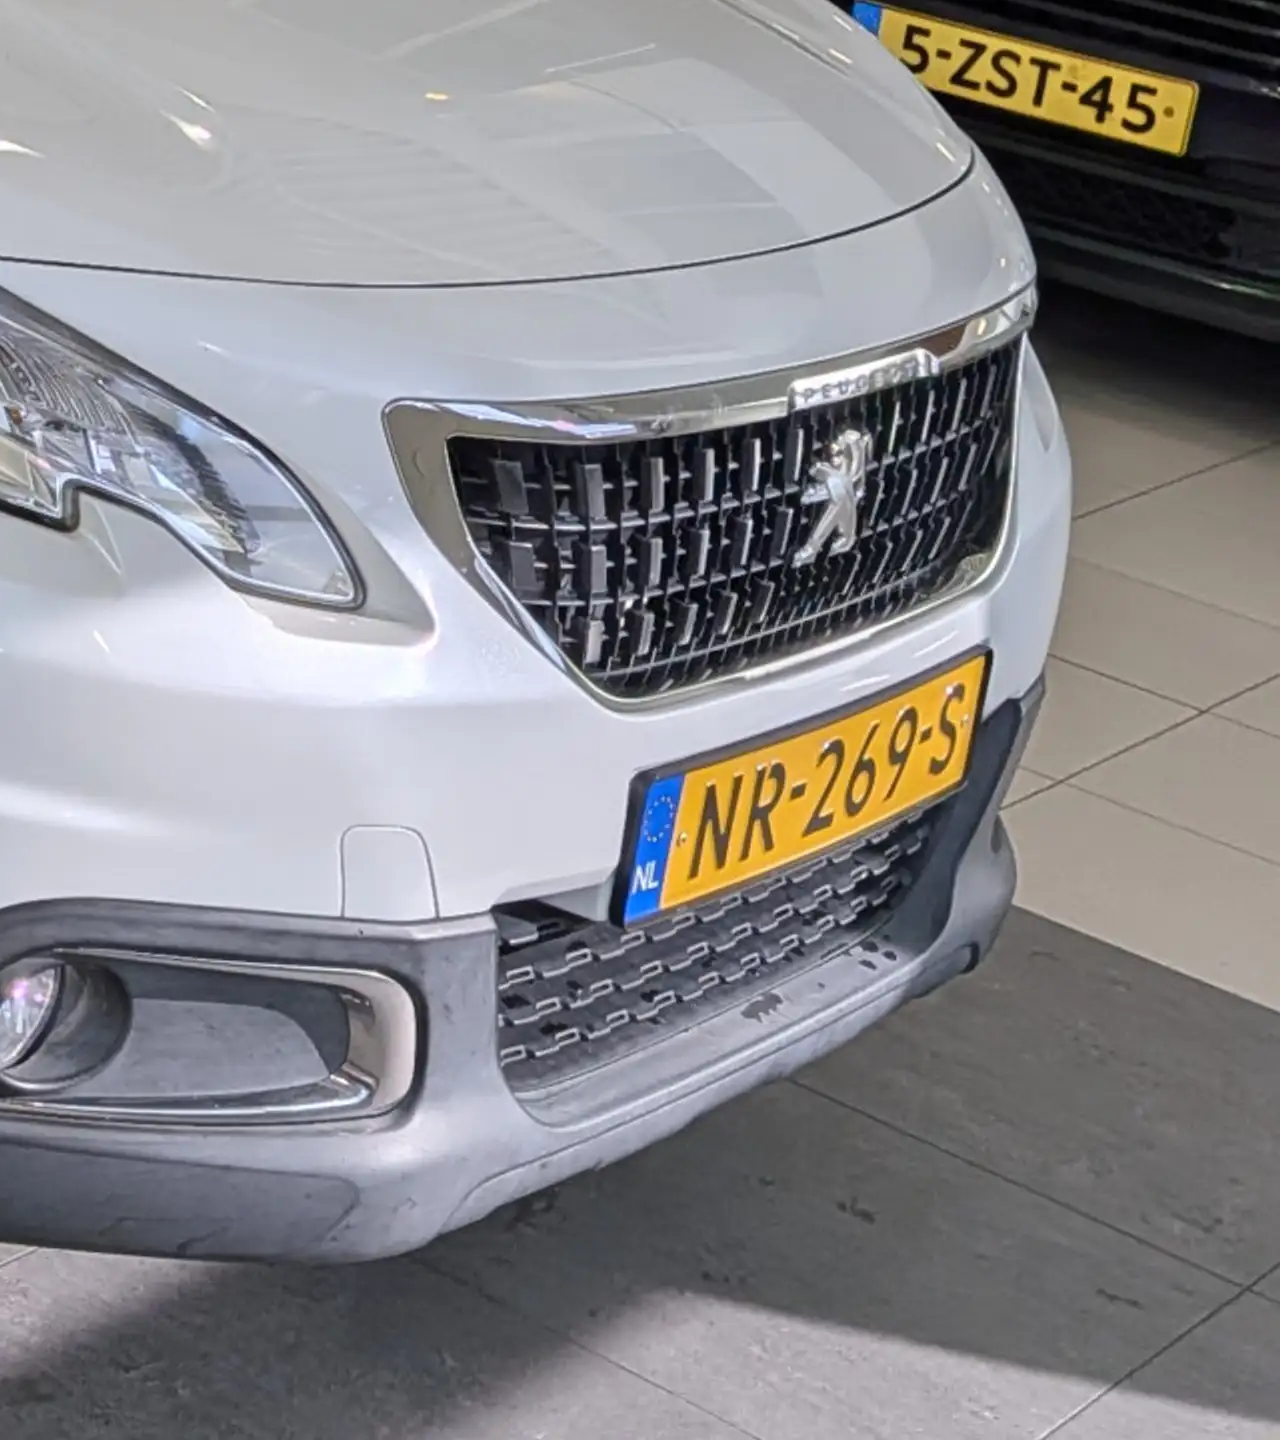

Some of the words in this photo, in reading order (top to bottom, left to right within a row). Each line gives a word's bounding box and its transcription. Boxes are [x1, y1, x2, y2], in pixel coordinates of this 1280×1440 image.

[899, 23, 1159, 134] 5-ZST-45
[801, 358, 919, 404] PEUGEOT
[687, 681, 967, 882] NR-269-S
[631, 860, 660, 896] NL
